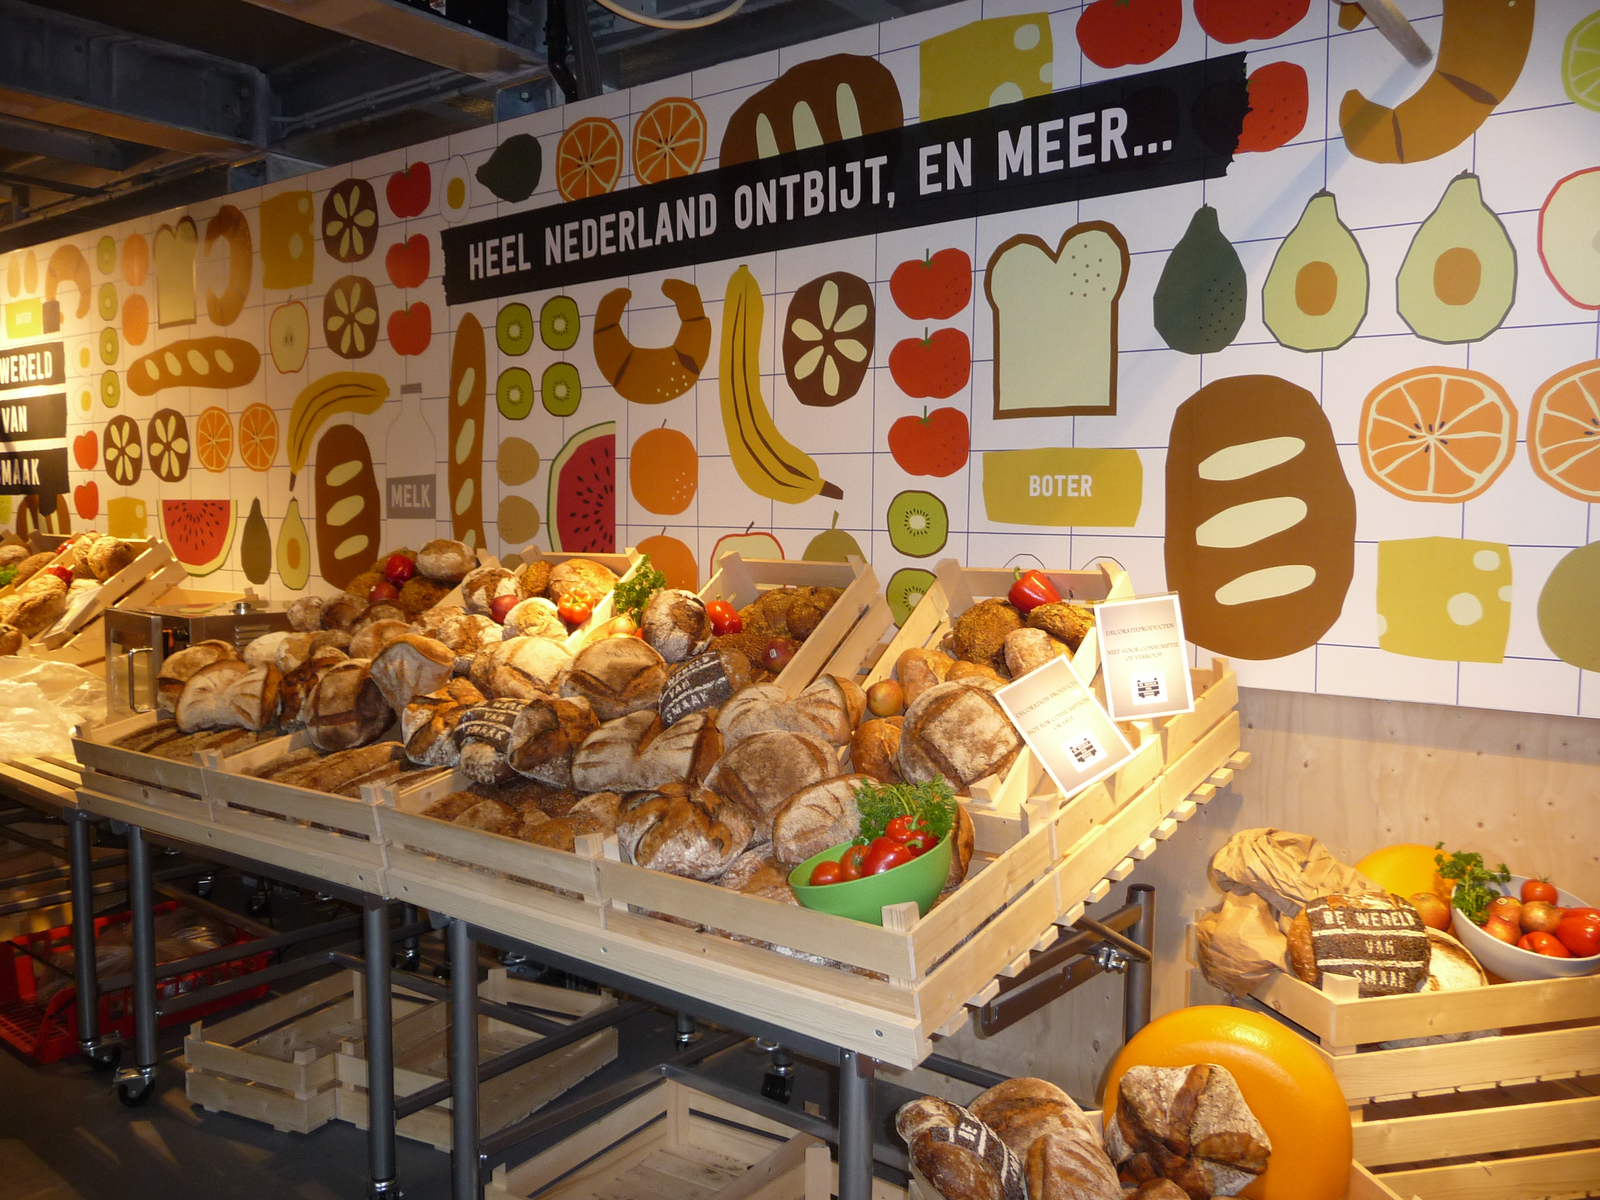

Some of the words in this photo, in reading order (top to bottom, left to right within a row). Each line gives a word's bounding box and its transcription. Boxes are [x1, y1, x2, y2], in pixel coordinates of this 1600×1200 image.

[469, 233, 531, 281] HEEL
[545, 193, 717, 266] NEDERLAND
[734, 155, 895, 230] ONTBIJT,
[919, 136, 972, 196] EN
[998, 107, 1173, 181] MEER...
[0, 351, 53, 385] WERELD
[1, 405, 28, 434] VAN
[0, 458, 41, 486] MAAK
[1029, 474, 1093, 497] BOTER
[391, 484, 431, 508] MELK
[1354, 910, 1416, 927] WERELD
